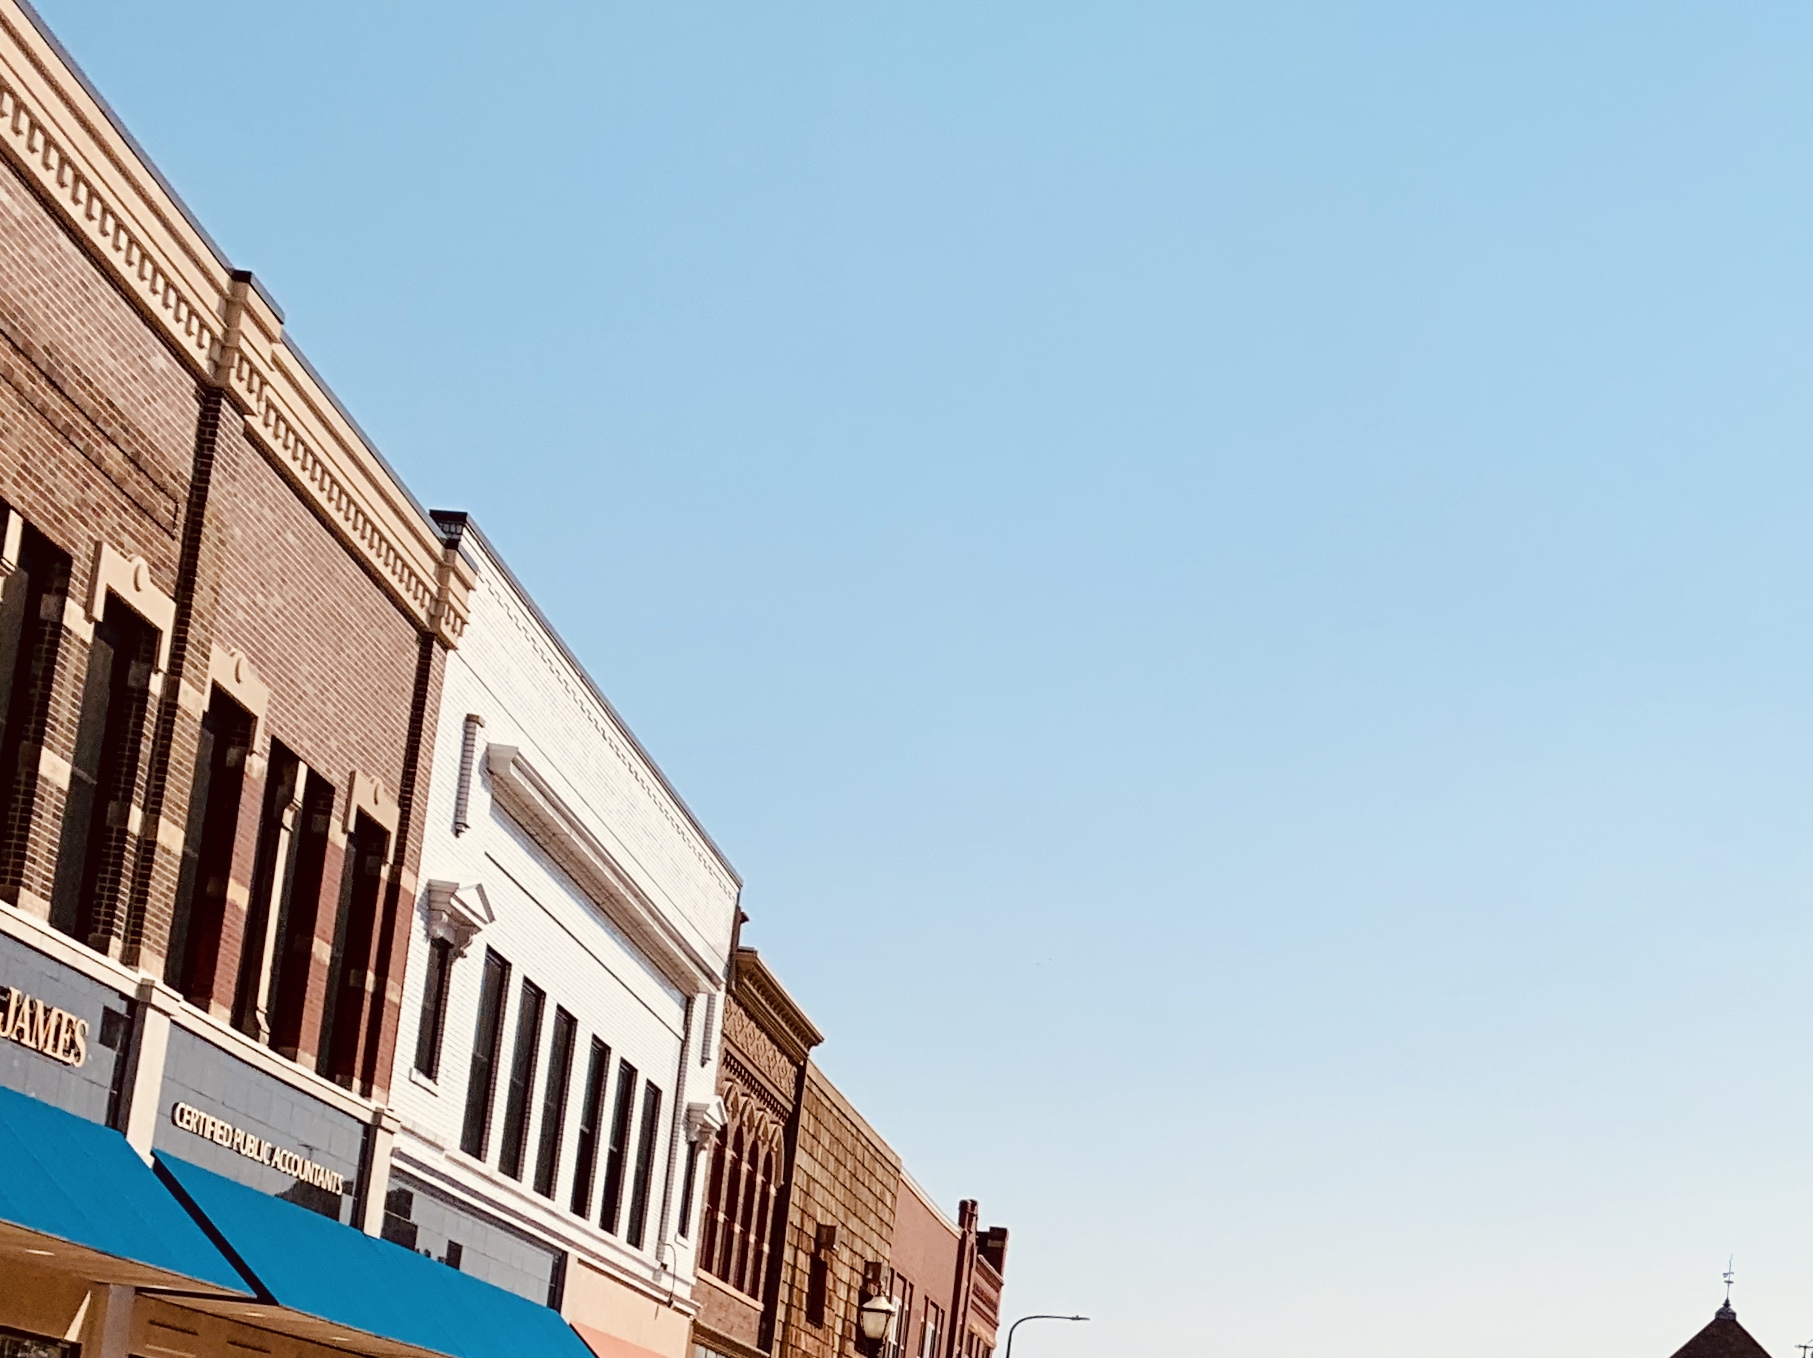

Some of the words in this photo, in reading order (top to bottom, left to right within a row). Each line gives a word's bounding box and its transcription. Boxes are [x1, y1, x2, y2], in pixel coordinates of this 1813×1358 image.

[0, 986, 90, 1069] JAMES
[174, 1101, 234, 1147] CERTIFIED
[233, 1127, 273, 1166] PUBLIC
[271, 1146, 344, 1196] ACCOUNTANTS
